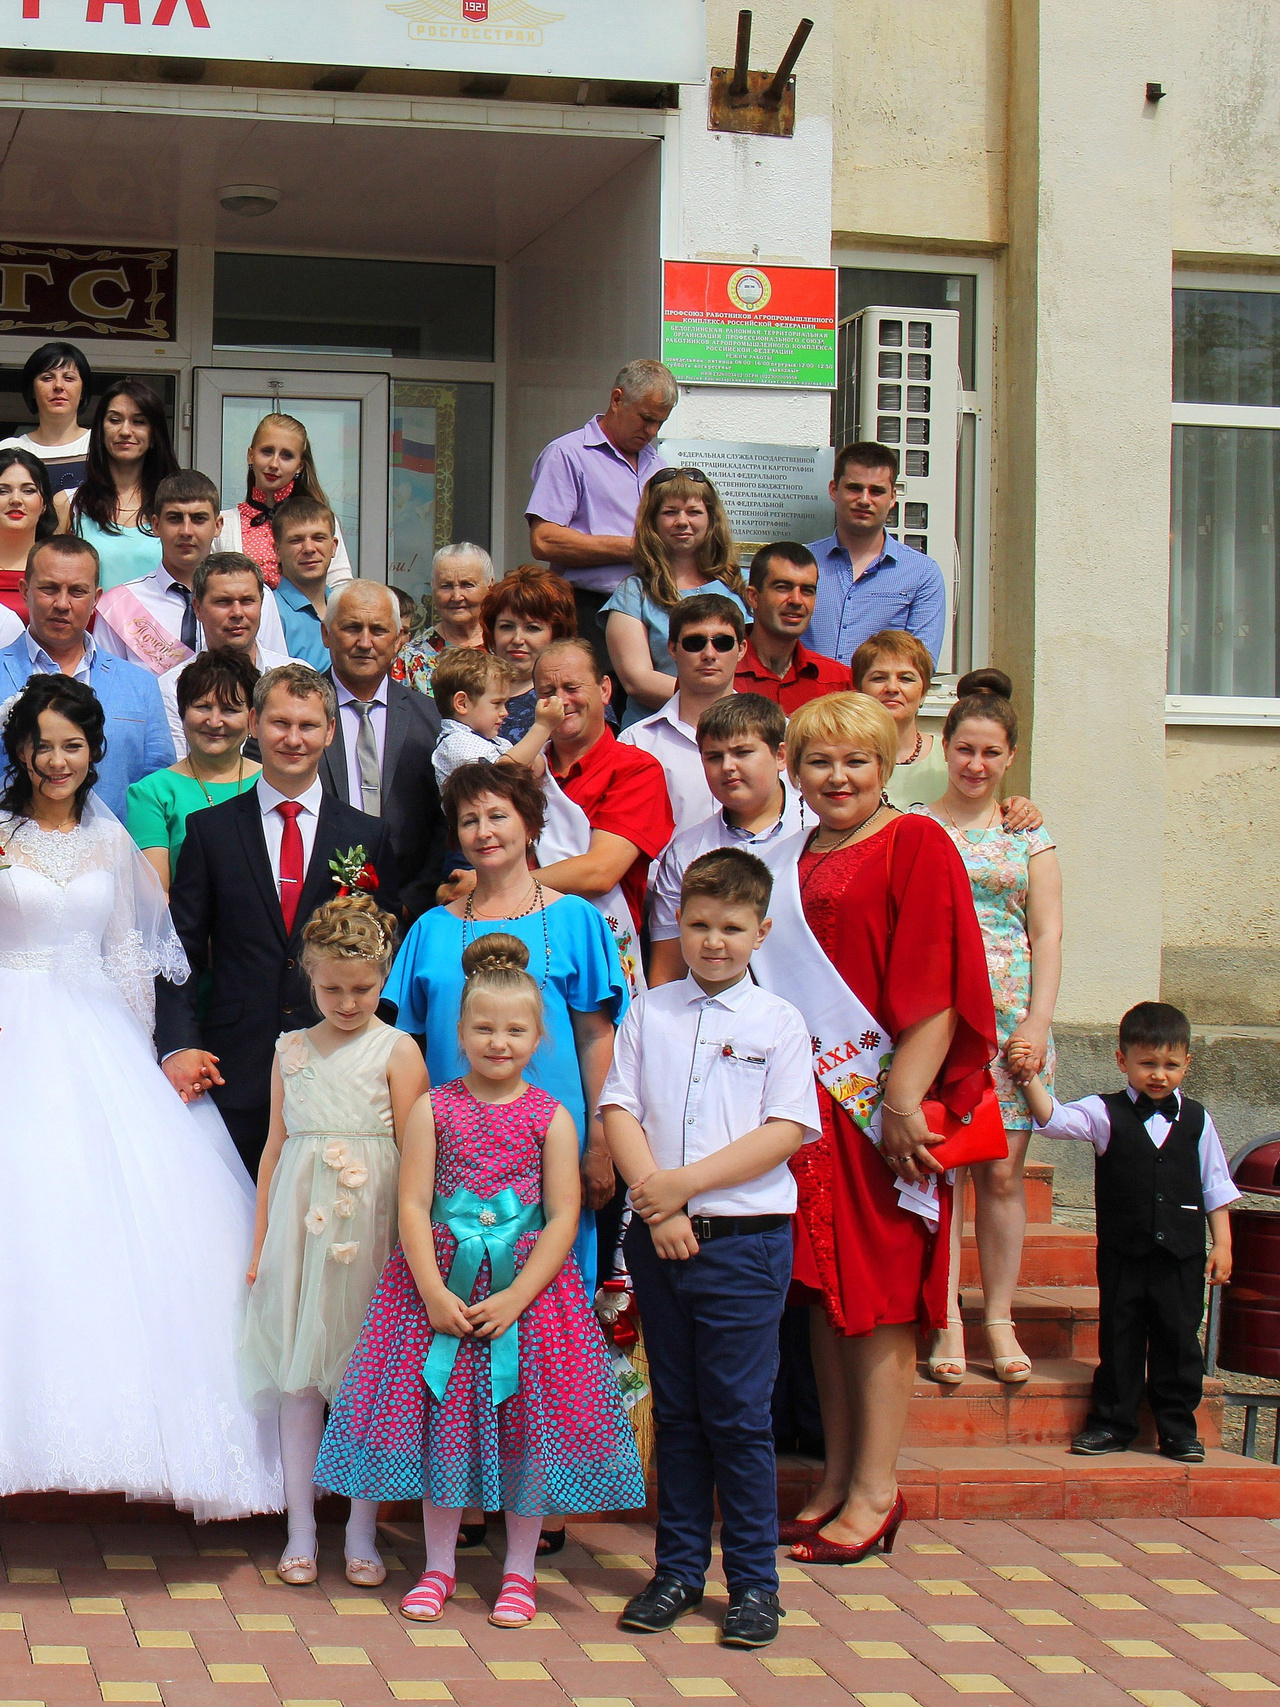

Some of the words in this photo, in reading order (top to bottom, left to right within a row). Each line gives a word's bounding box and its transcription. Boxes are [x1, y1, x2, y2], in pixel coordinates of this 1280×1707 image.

[465, 2, 486, 12] 1921
[417, 25, 535, 42] РОСГОССТРАХ
[682, 317, 725, 325] КОМПЛЕКСА
[727, 320, 772, 328] РОССИЙСКОЙ
[774, 322, 816, 330] ФЕДЕРАЦИИ
[754, 314, 834, 324] АГРОПРОМЫШЛЕННОГО
[670, 325, 723, 333] БЕЛОГЛИНСКАЯ
[725, 327, 761, 335] РАЙОННАЯ
[764, 330, 828, 338] ТЕРРИТОРИАЛЬНАЯ
[673, 331, 722, 339] ОРГАНИЗАЦИЯ
[725, 334, 800, 343] ПРОФЕССИОНАЛЬНОГО
[706, 345, 751, 353] РОССИЙСКОЙ
[753, 347, 793, 355] ФЕДЕРАЦИИ
[712, 340, 790, 349] АГРОПРОМЫШЛЕННОГО
[792, 343, 833, 351] КОМПЛЕКСА
[678, 451, 725, 459] ФЕДЕРАЛЬНАЯ
[726, 453, 753, 461] СЛУЖБА
[754, 454, 815, 464] ГОСУДАРСТВЕННОЙ
[768, 465, 814, 473] КАРТОГРАФИИ
[737, 472, 787, 480] ФЕДЕРАЛЬНОГО
[758, 483, 803, 491] БЮДЖЕТНОГО
[737, 500, 784, 508] ФЕДЕРАЛЬНОЙ
[816, 1040, 861, 1076] АХА
